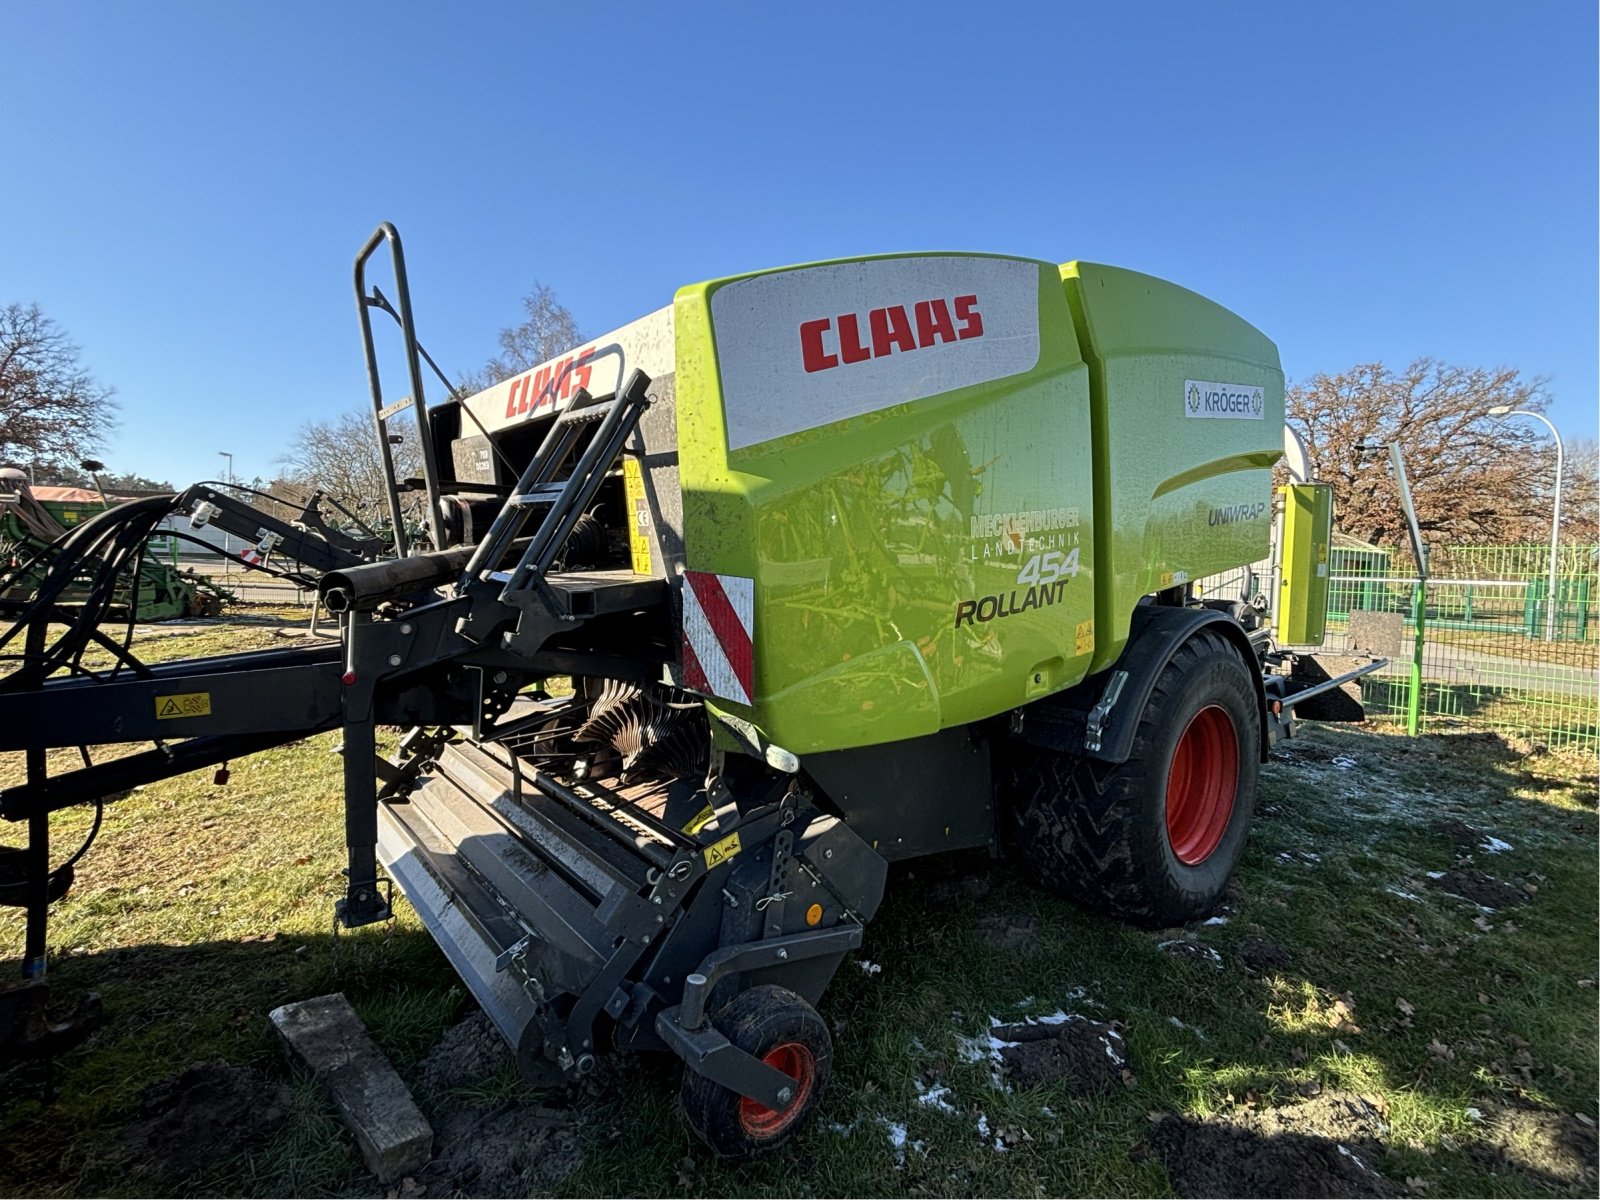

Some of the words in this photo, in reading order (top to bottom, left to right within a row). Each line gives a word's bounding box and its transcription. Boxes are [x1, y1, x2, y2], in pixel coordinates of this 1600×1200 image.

[800, 295, 983, 373] CLAAS
[505, 346, 596, 419] CLAAS
[1205, 387, 1250, 413] KRÖGER
[970, 507, 1080, 539] MECKLENBURGER
[1208, 502, 1265, 526] UNIWRAP
[971, 532, 1080, 560] LANDTECHNIK
[1017, 548, 1080, 587] 454
[955, 579, 1069, 628] ROLLANT
